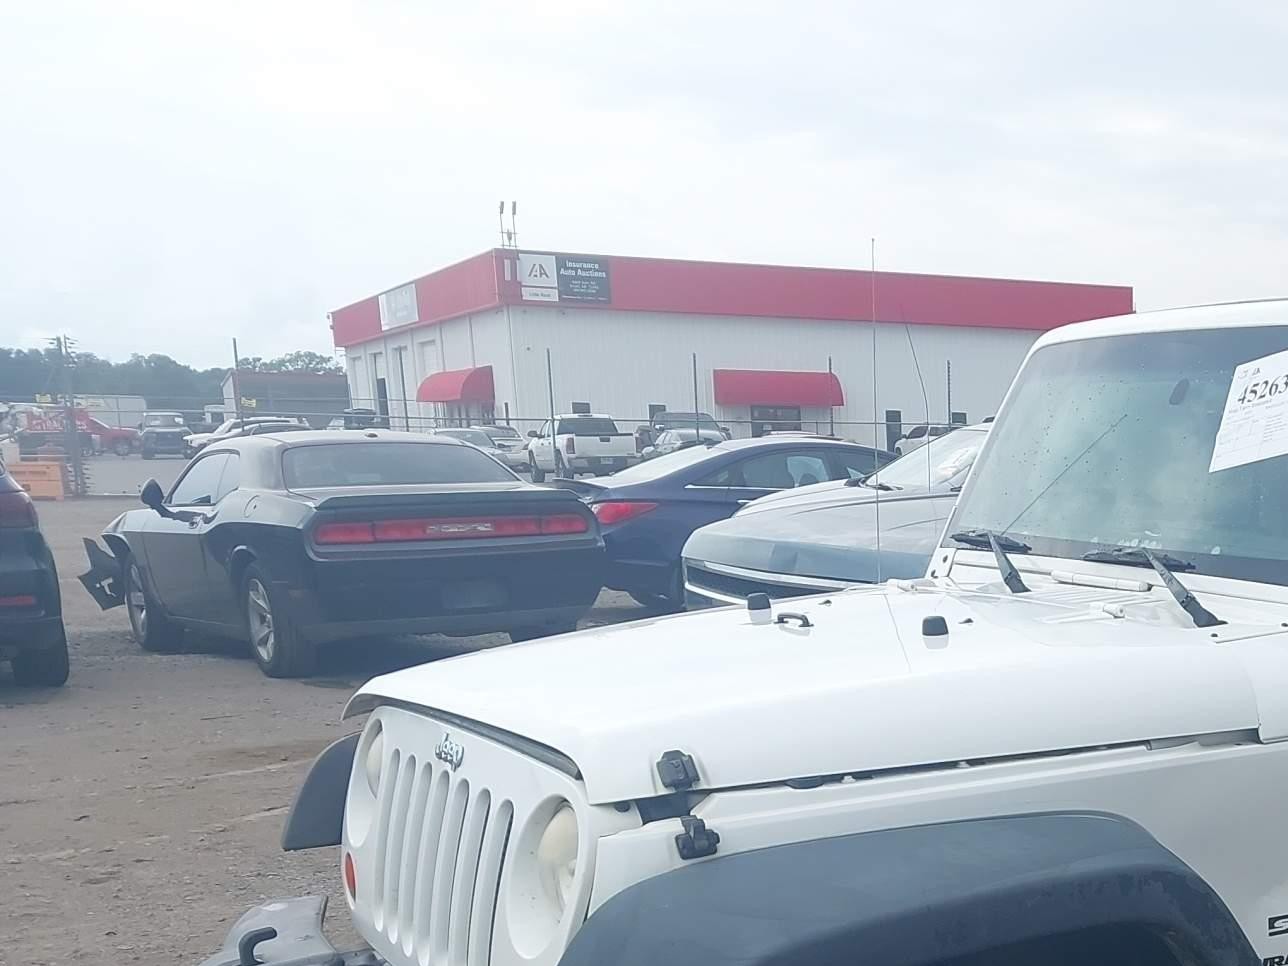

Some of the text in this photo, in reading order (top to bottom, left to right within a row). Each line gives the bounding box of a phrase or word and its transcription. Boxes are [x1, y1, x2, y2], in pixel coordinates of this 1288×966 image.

[566, 260, 599, 269] Insurance
[560, 268, 606, 278] Auto Auctions
[435, 732, 464, 772] Jeep
